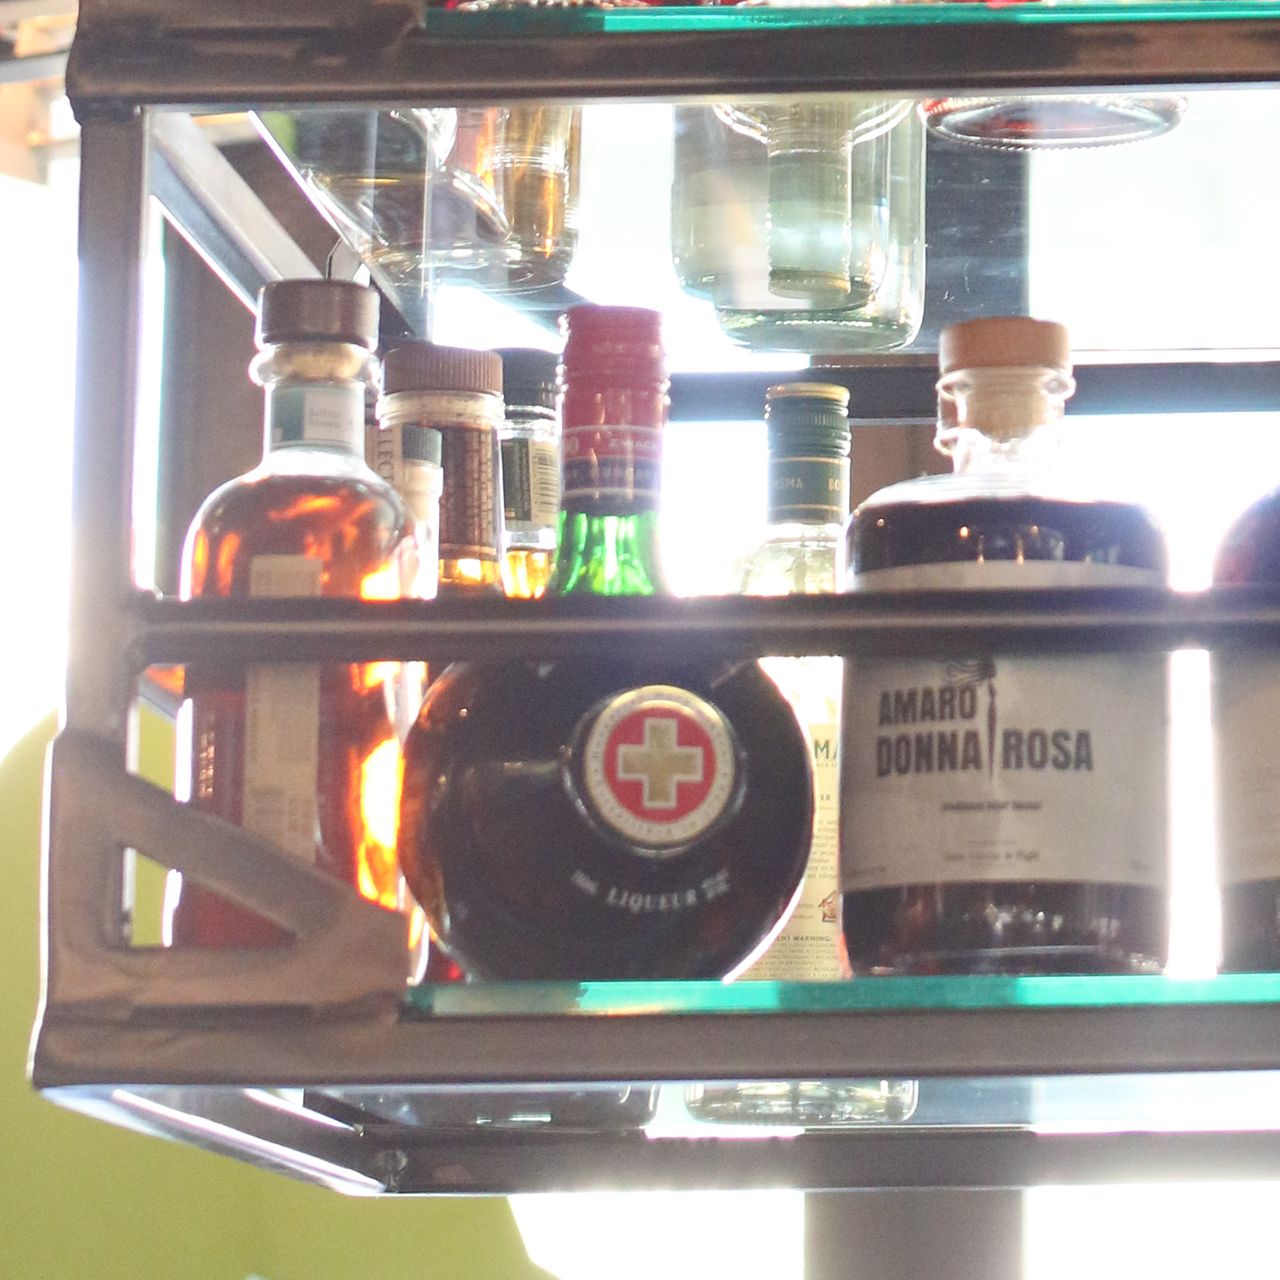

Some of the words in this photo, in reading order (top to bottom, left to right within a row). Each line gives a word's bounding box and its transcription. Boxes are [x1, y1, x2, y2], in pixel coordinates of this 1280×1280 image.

[877, 686, 979, 727] AMARO
[876, 727, 983, 778] DONNA
[1002, 727, 1095, 773] ROSA
